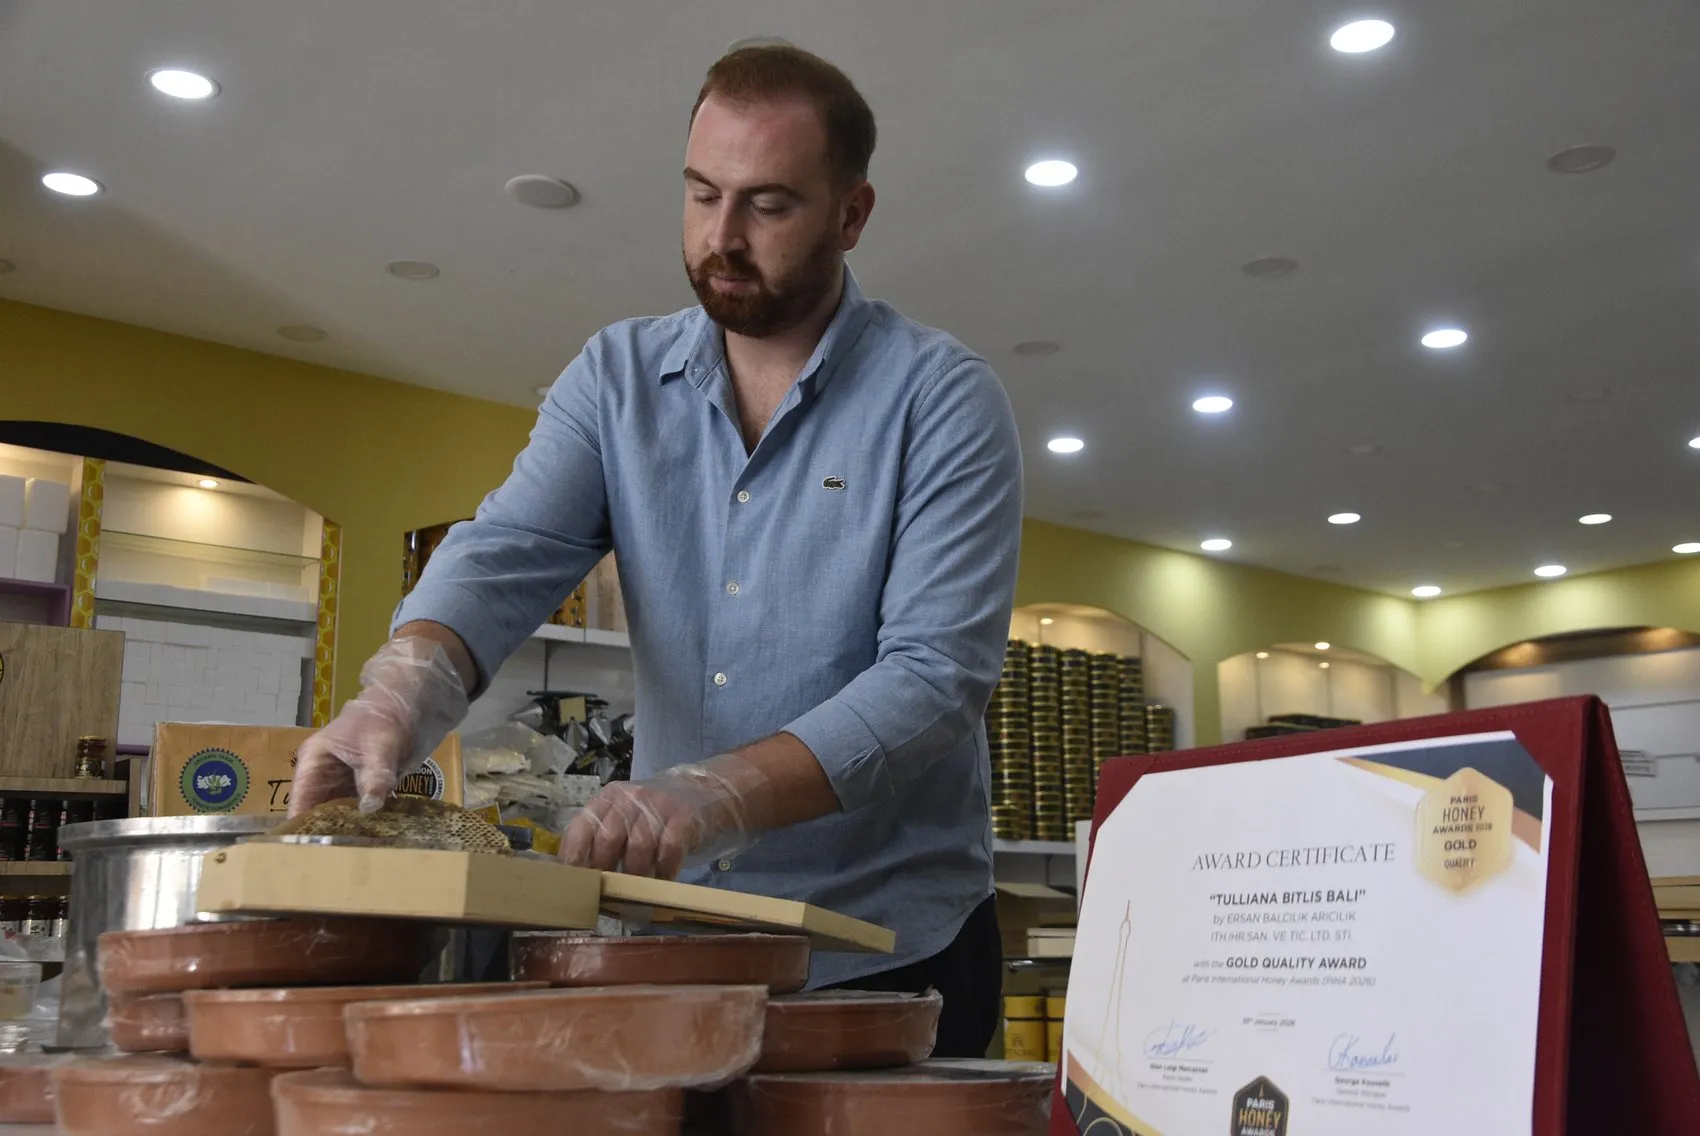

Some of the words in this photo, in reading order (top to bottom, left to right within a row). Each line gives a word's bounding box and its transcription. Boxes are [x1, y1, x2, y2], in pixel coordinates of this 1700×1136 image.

[1450, 794, 1478, 804] PARIS
[1442, 805, 1485, 823] HONEY
[1432, 823, 1473, 834] AWARDS
[1444, 838, 1477, 851] GOLD
[1191, 852, 1262, 872] AWARD
[1266, 843, 1396, 867] CERTIFICATE
[1444, 857, 1475, 870] QUALITY
[1282, 890, 1322, 904] BITLIS
[1213, 913, 1225, 925] by
[1227, 912, 1261, 924] ERSAN
[1273, 930, 1286, 942] VE
[1226, 957, 1259, 969] GOLD
[1262, 957, 1315, 969] QUALITY
[1318, 957, 1367, 969] AWARD
[1247, 1097, 1275, 1109] PARIS
[1238, 1109, 1281, 1129] HONEY
